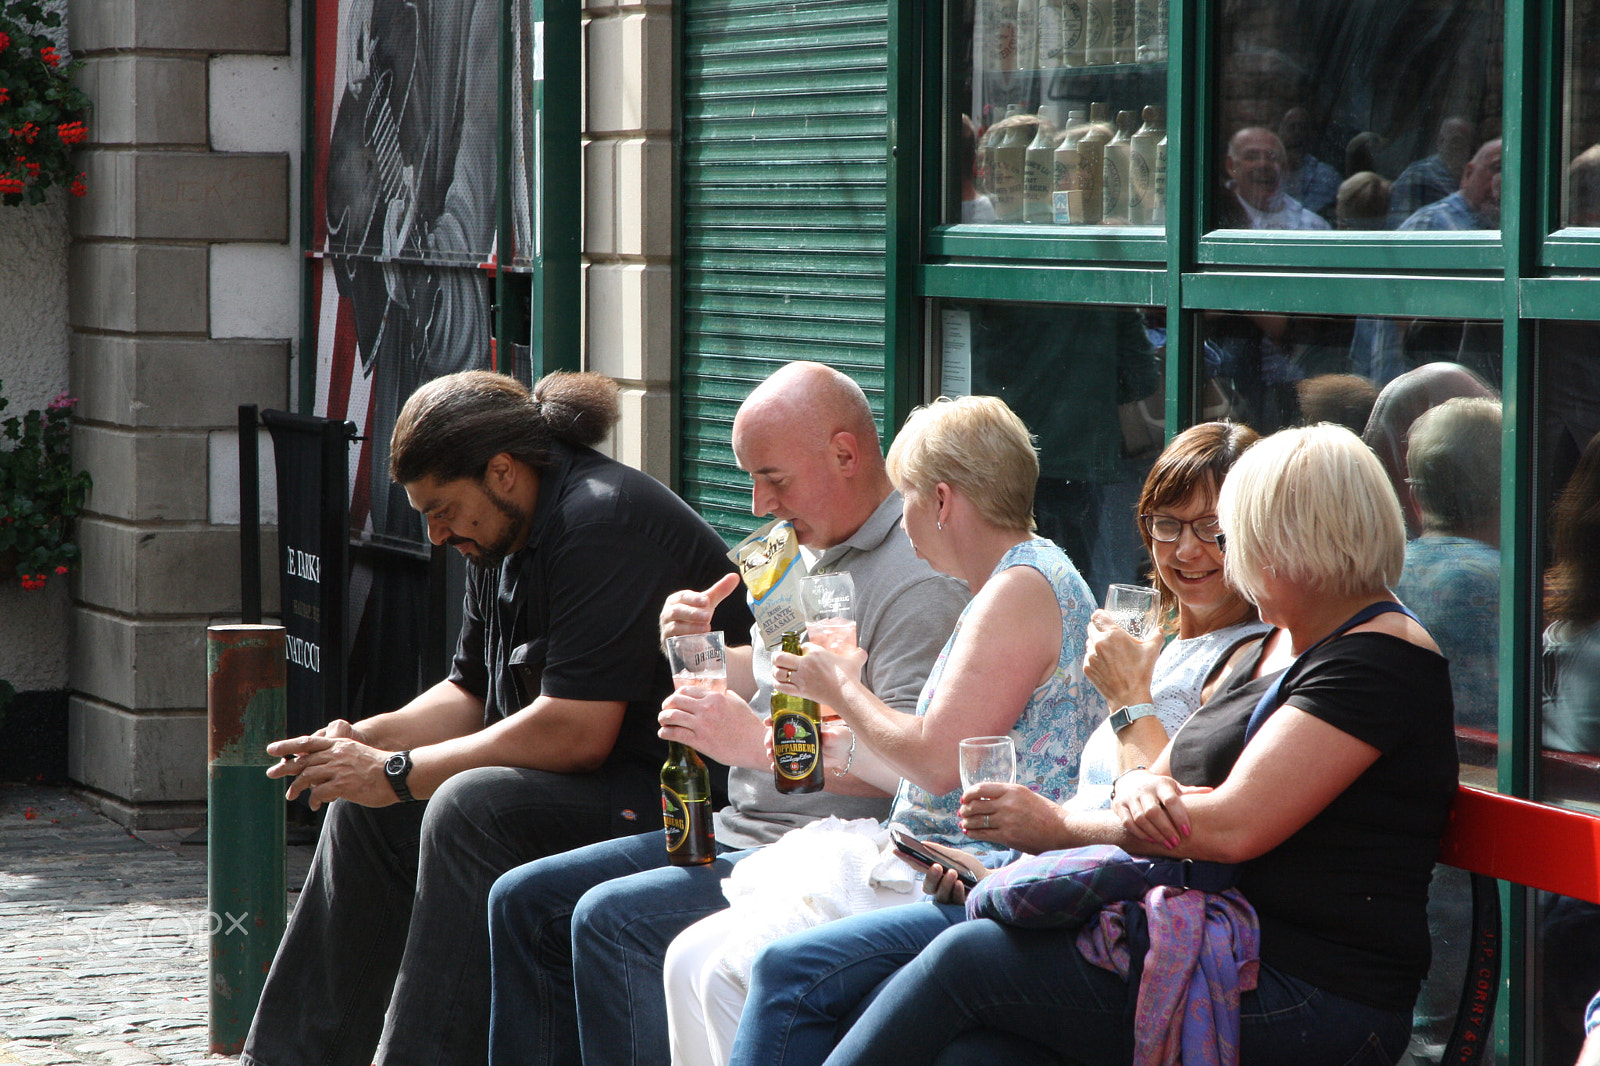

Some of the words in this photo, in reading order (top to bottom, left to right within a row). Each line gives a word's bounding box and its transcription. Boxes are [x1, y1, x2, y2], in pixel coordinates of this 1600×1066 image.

[762, 605, 793, 629] ATLANTIC
[765, 624, 780, 636] SEA
[778, 612, 796, 627] SALT
[1470, 968, 1491, 1027] CORRY
[1464, 1030, 1478, 1042] &
